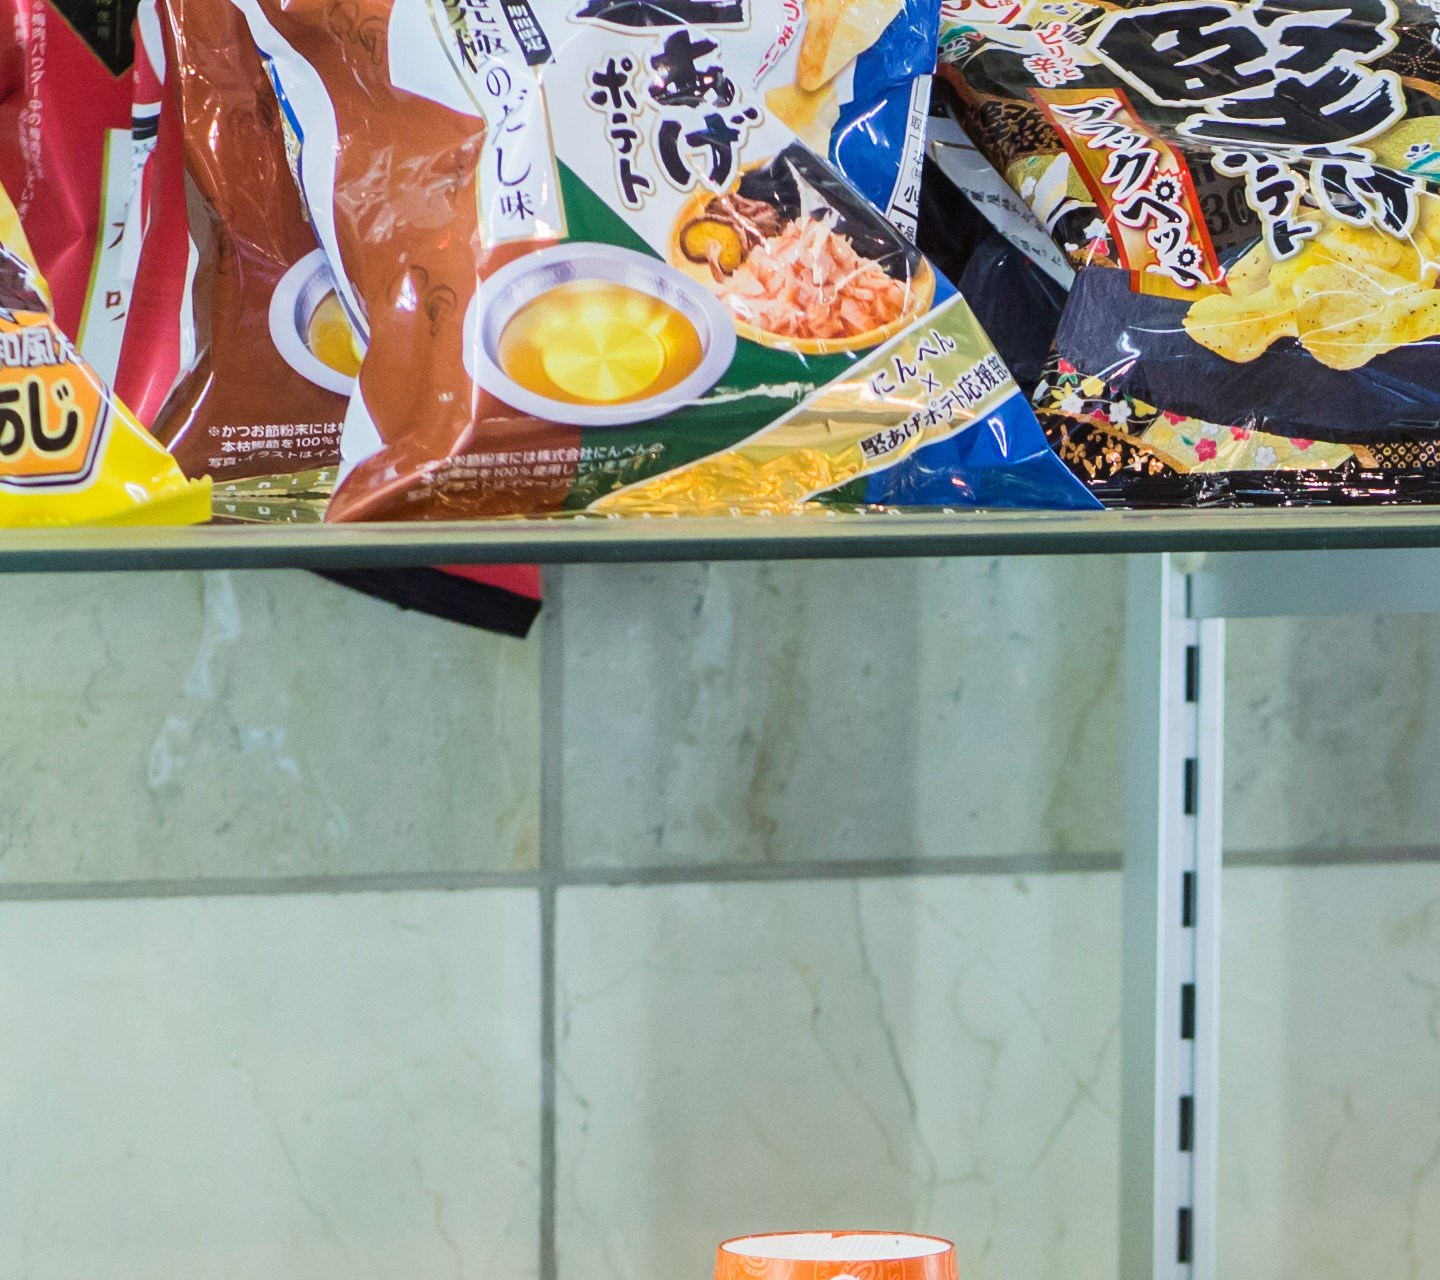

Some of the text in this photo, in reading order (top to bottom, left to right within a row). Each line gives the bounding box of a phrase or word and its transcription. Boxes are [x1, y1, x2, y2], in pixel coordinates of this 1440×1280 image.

[591, 56, 653, 203] ポテト
[872, 331, 955, 396] にんべん
